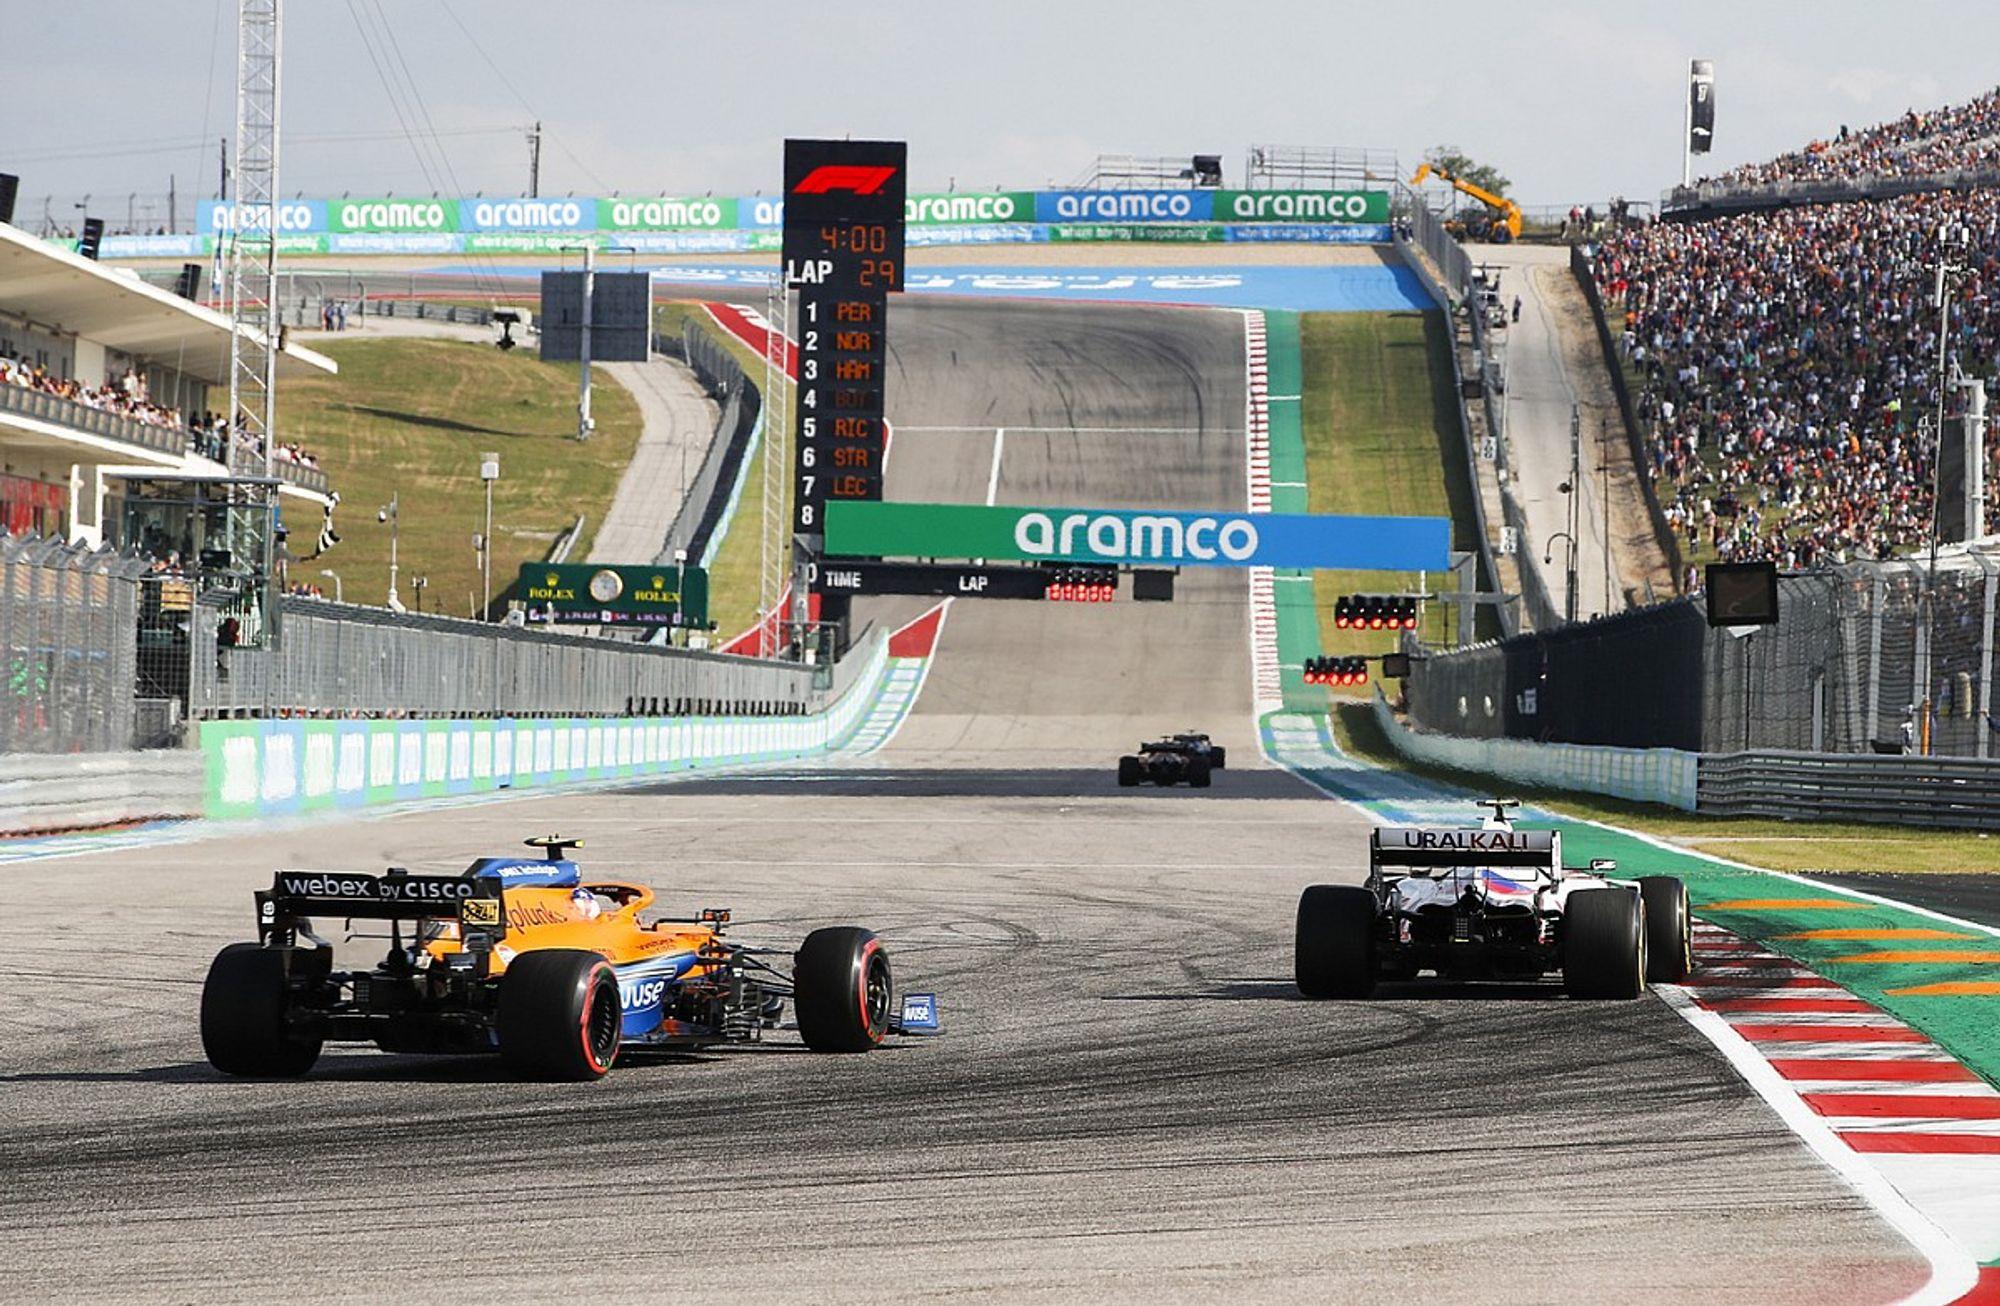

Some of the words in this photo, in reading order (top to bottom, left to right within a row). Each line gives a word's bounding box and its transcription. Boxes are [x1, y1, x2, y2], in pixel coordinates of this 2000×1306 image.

[792, 165, 898, 195] F1
[341, 203, 444, 229] aramco
[475, 202, 581, 227] aramco
[612, 202, 721, 226] aramco
[1056, 195, 1191, 217] aramco
[1233, 194, 1367, 217] aramco
[821, 225, 886, 253] 4:00
[788, 259, 834, 284] LAP
[859, 259, 895, 286] 29
[806, 301, 817, 322] 1
[837, 302, 871, 322] PER
[805, 331, 818, 351] 2
[836, 331, 871, 351] NOR
[804, 359, 818, 380] 3
[803, 388, 817, 409] 4
[803, 417, 816, 438] 5
[834, 417, 869, 438] RIC
[802, 446, 816, 467] 6
[834, 447, 869, 467] STR
[802, 475, 815, 497] 7
[833, 475, 868, 496] LEC
[801, 504, 814, 526] 8
[1014, 512, 1259, 561] aramco
[825, 571, 862, 588] TIME
[959, 575, 988, 592] LAP
[529, 588, 574, 600] ROLEX
[634, 590, 680, 602] ROLEX
[1404, 831, 1528, 850] URALKALI
[285, 874, 371, 898] webex
[379, 881, 400, 899] by
